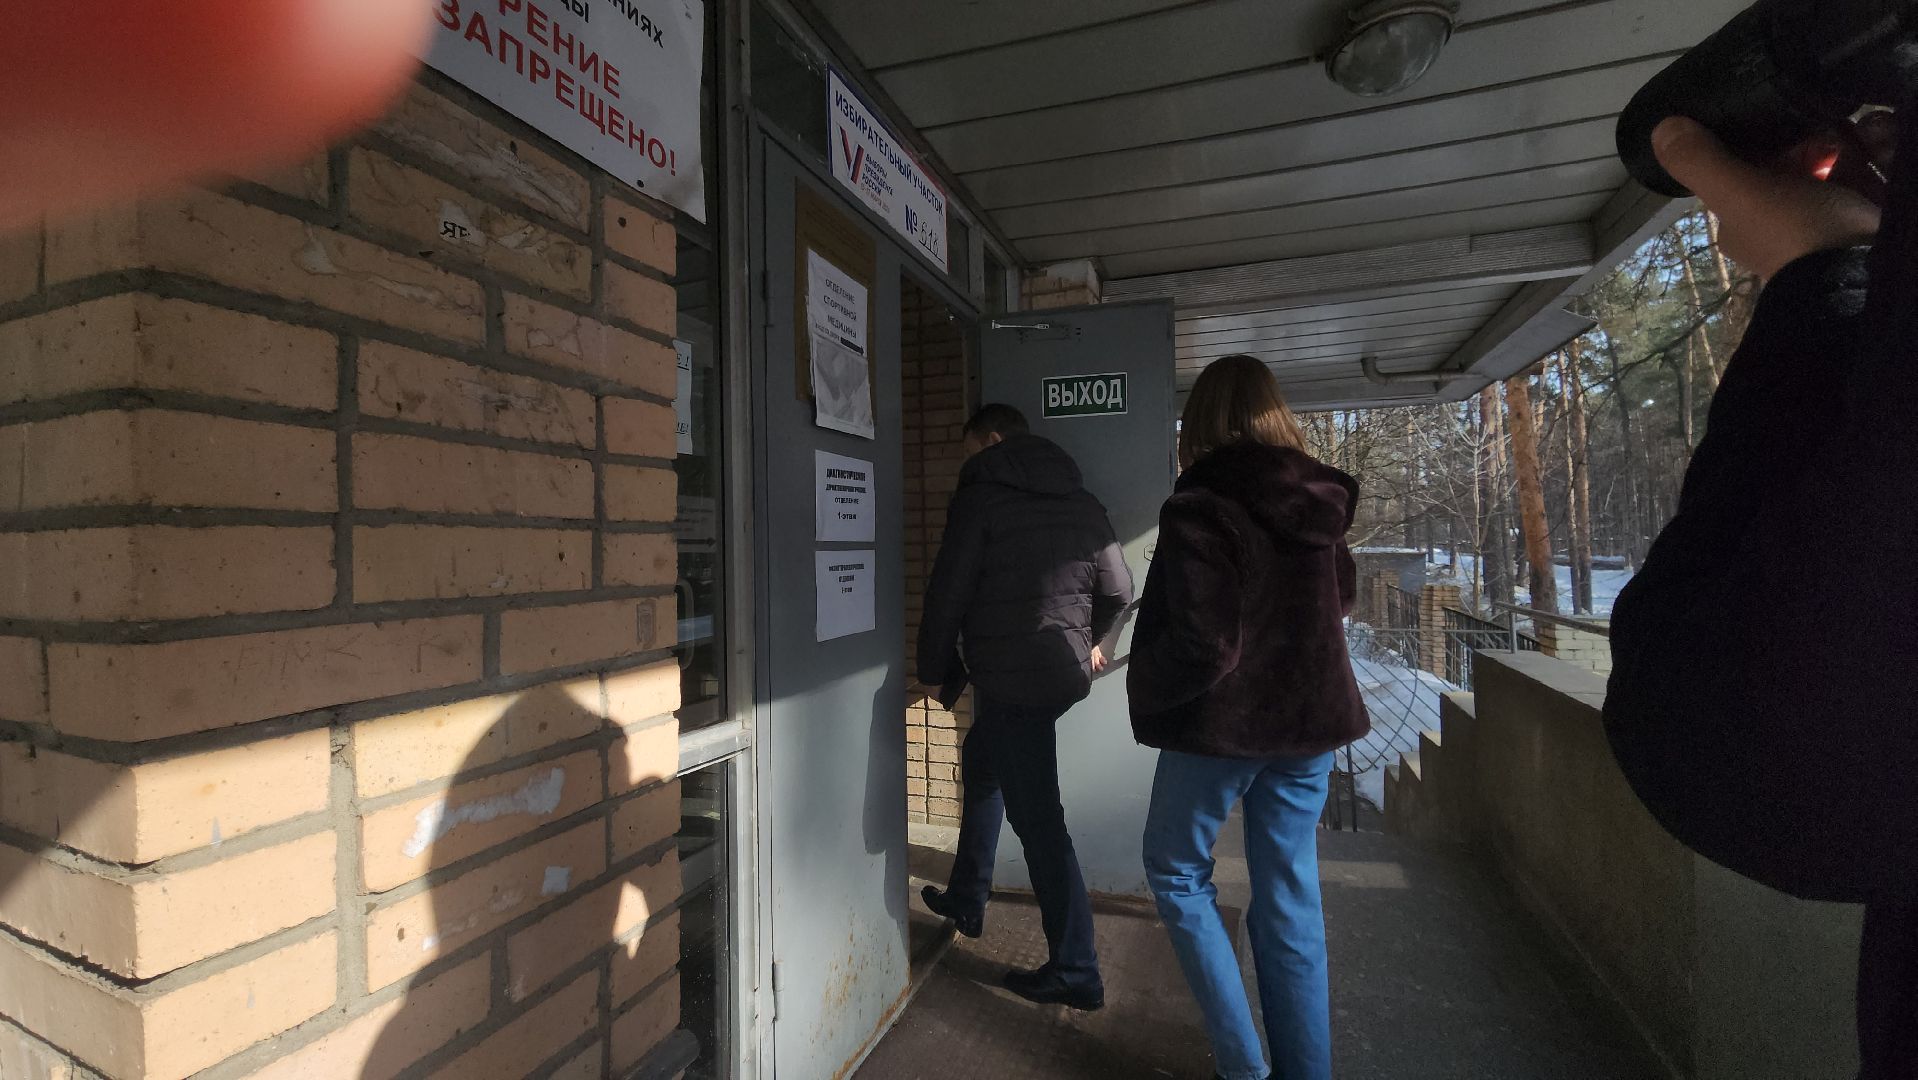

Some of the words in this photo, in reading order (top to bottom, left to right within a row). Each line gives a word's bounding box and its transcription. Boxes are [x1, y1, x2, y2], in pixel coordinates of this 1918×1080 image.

[432, 0, 676, 177] ЗАПРЕЩЕНО!
[835, 90, 912, 184] ИЗБИРАТЕЛЬНЫЙ
[913, 171, 944, 217] УЧАСТОК
[865, 164, 893, 196] ПРЕЗИДЕНТА
[905, 204, 919, 236] №
[823, 295, 857, 321] СПОРТИВНОЙ
[1048, 379, 1122, 409] ВЫХОД
